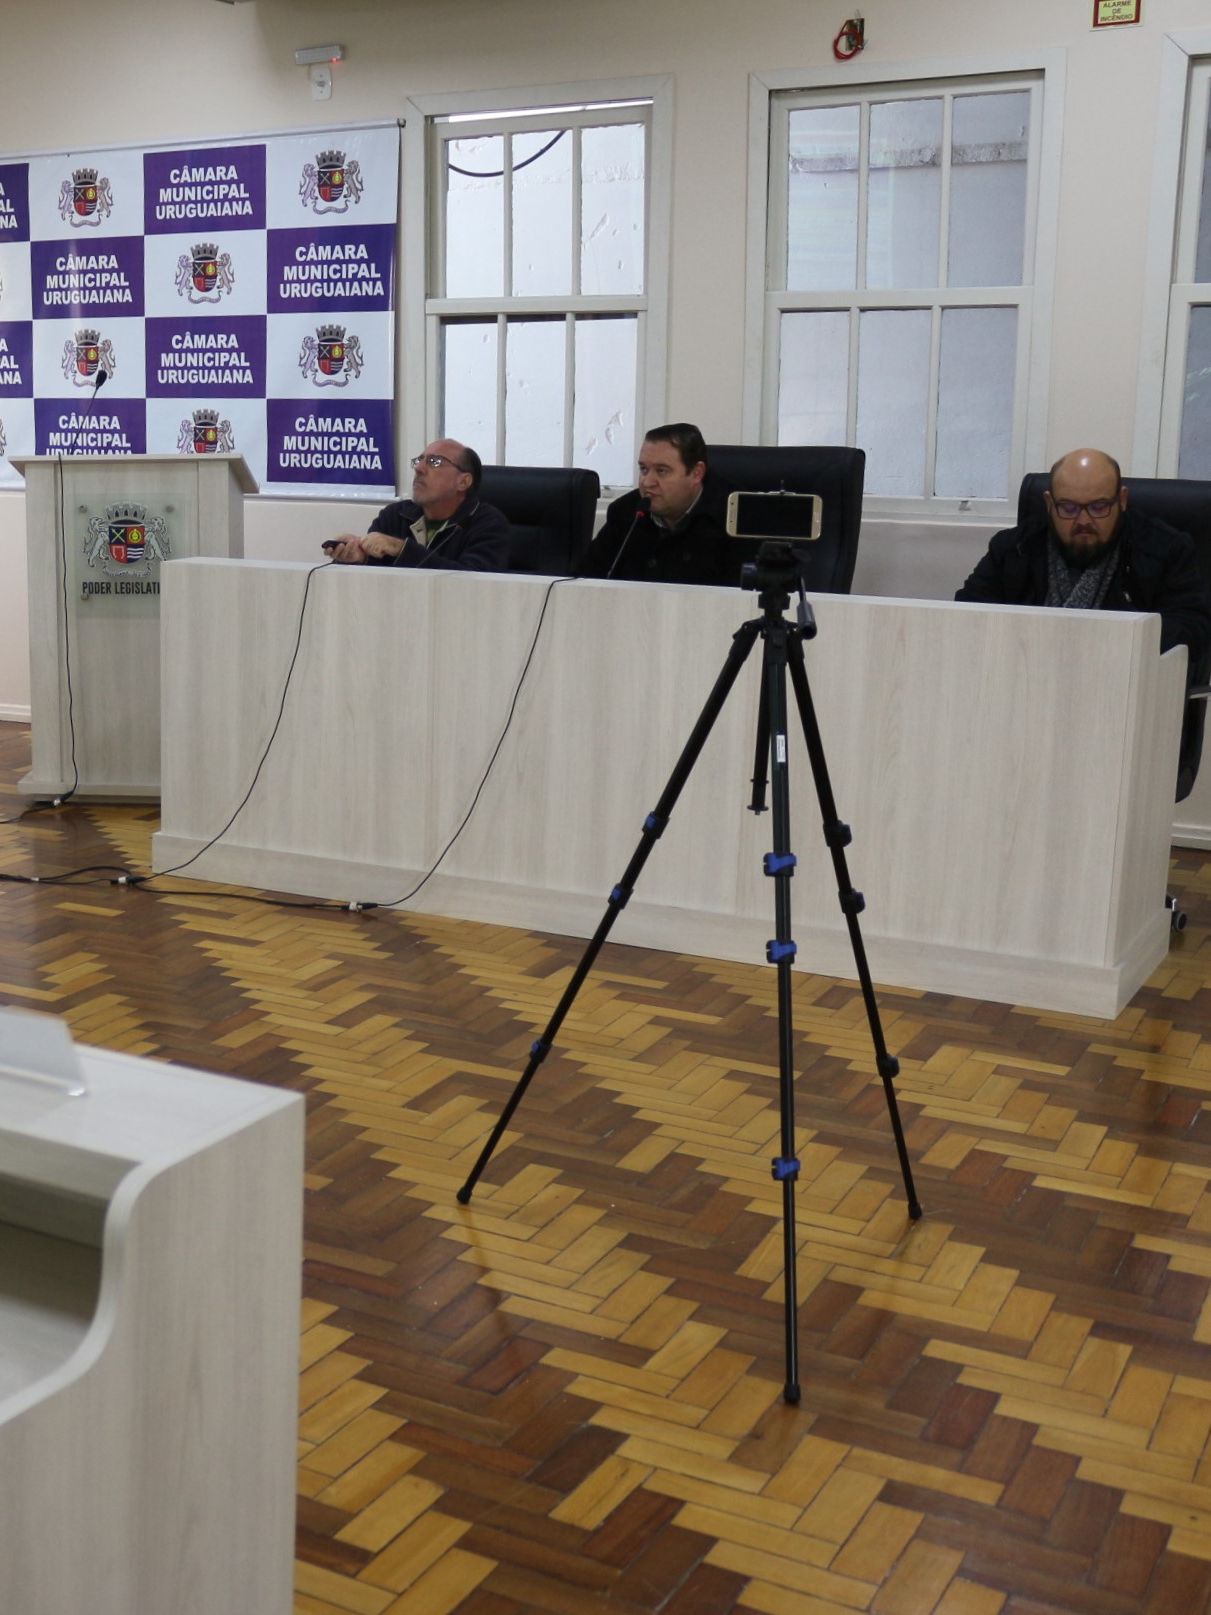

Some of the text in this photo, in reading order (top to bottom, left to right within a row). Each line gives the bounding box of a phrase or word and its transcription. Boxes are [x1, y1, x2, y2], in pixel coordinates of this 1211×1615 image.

[1103, 0, 1132, 8] ALARME
[169, 165, 238, 183] CÂMARA
[159, 183, 250, 202] MUNICIPAL
[156, 201, 253, 220] URUGUAIANA
[295, 243, 369, 262] CÂMARA
[56, 254, 119, 271] CÂMARA
[46, 272, 130, 288] MUNICIPAL
[283, 263, 381, 281] MUNICIPAL
[43, 288, 133, 305] URUGUAIANA
[279, 280, 385, 298] URUGUAIANA
[171, 331, 239, 349] CÂMARA
[161, 351, 250, 367] MUNICIPAL
[157, 369, 254, 384] URUGUAIANA
[58, 412, 121, 430] CÂMARA
[295, 414, 368, 433] CÂMARA
[49, 432, 131, 447] MUNICIPAL
[283, 435, 379, 452] MUNICIPAL
[279, 452, 382, 470] URUGUAIANA
[82, 581, 160, 595] PODER LEGISLATI
